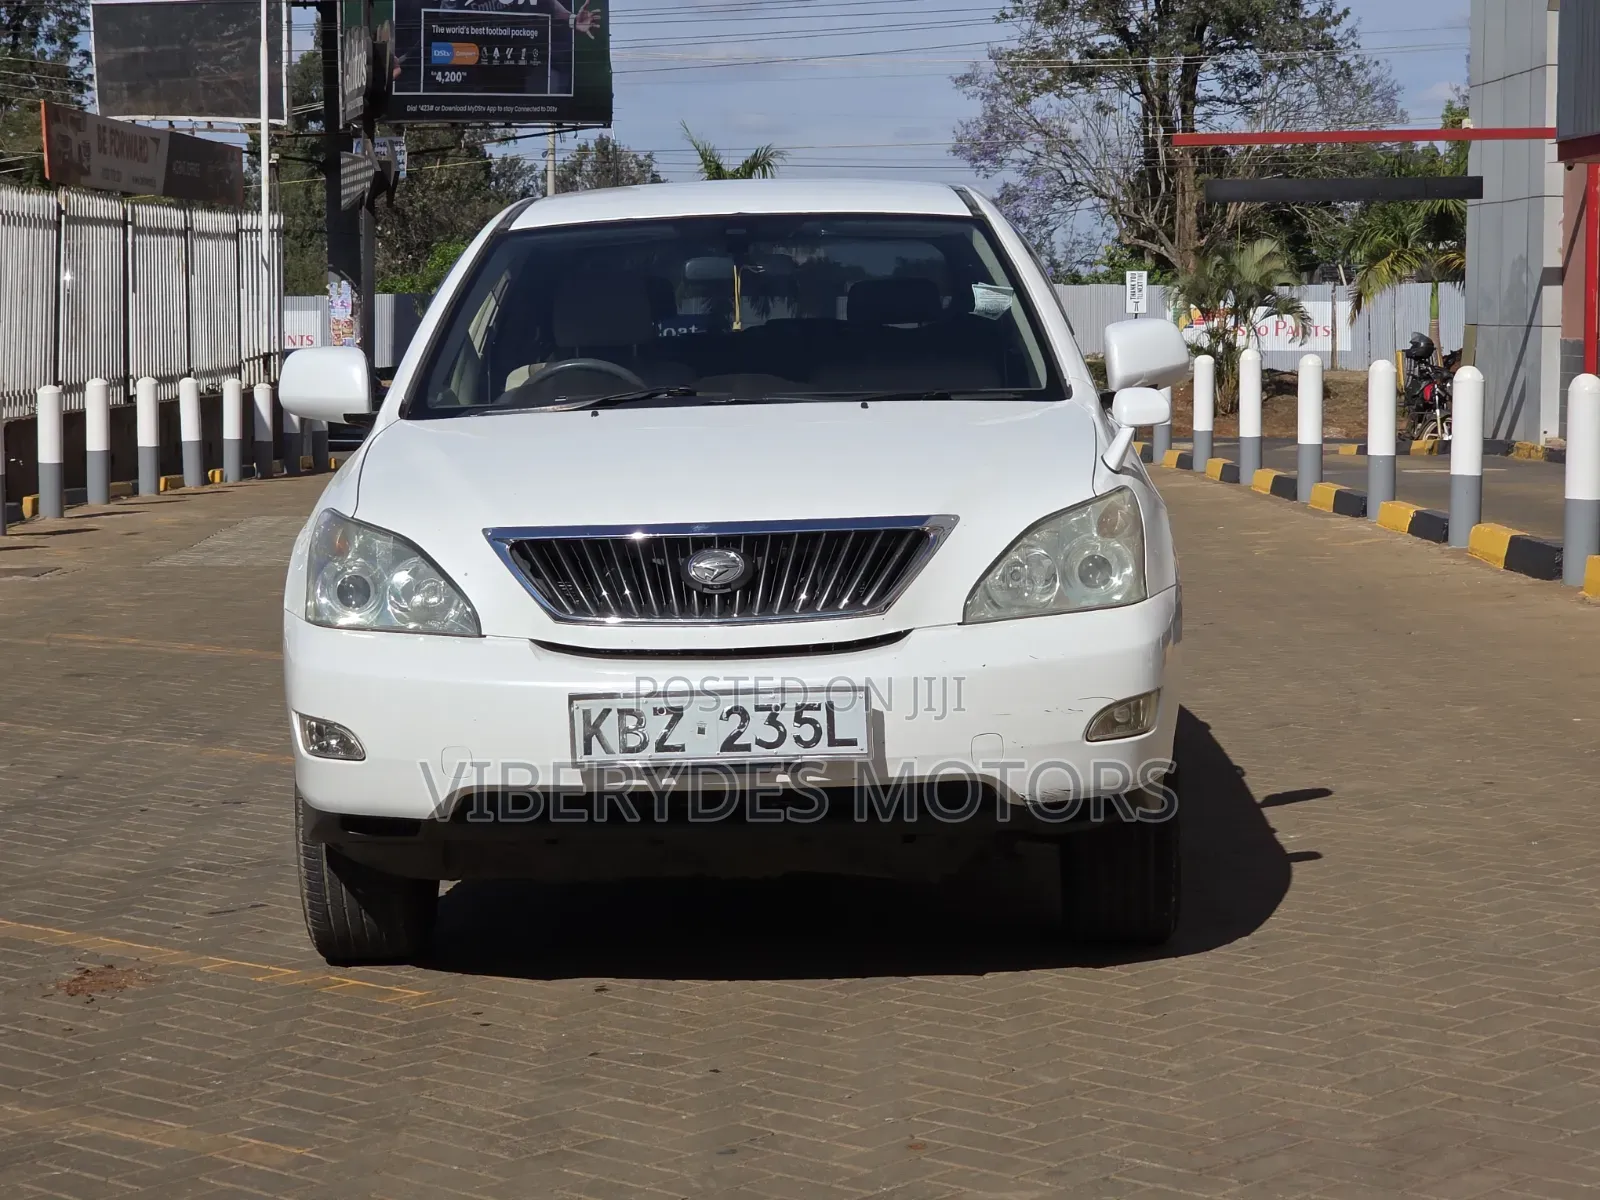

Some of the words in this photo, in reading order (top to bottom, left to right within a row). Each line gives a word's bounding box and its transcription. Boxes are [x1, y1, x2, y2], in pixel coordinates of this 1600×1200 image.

[432, 25, 444, 34] The
[446, 26, 469, 35] world's
[471, 26, 485, 35] best
[486, 27, 510, 36] football
[511, 28, 538, 39] package
[433, 49, 452, 57] DStv
[436, 71, 463, 84] 4,200
[406, 103, 418, 112] Dial
[441, 104, 467, 112] Download
[467, 104, 486, 114] MyDStv
[487, 105, 497, 114] App
[503, 105, 514, 114] stay
[96, 123, 107, 155] BE
[109, 128, 149, 164] FORWARD
[581, 704, 687, 757] KBZ
[718, 700, 858, 753] 235L
